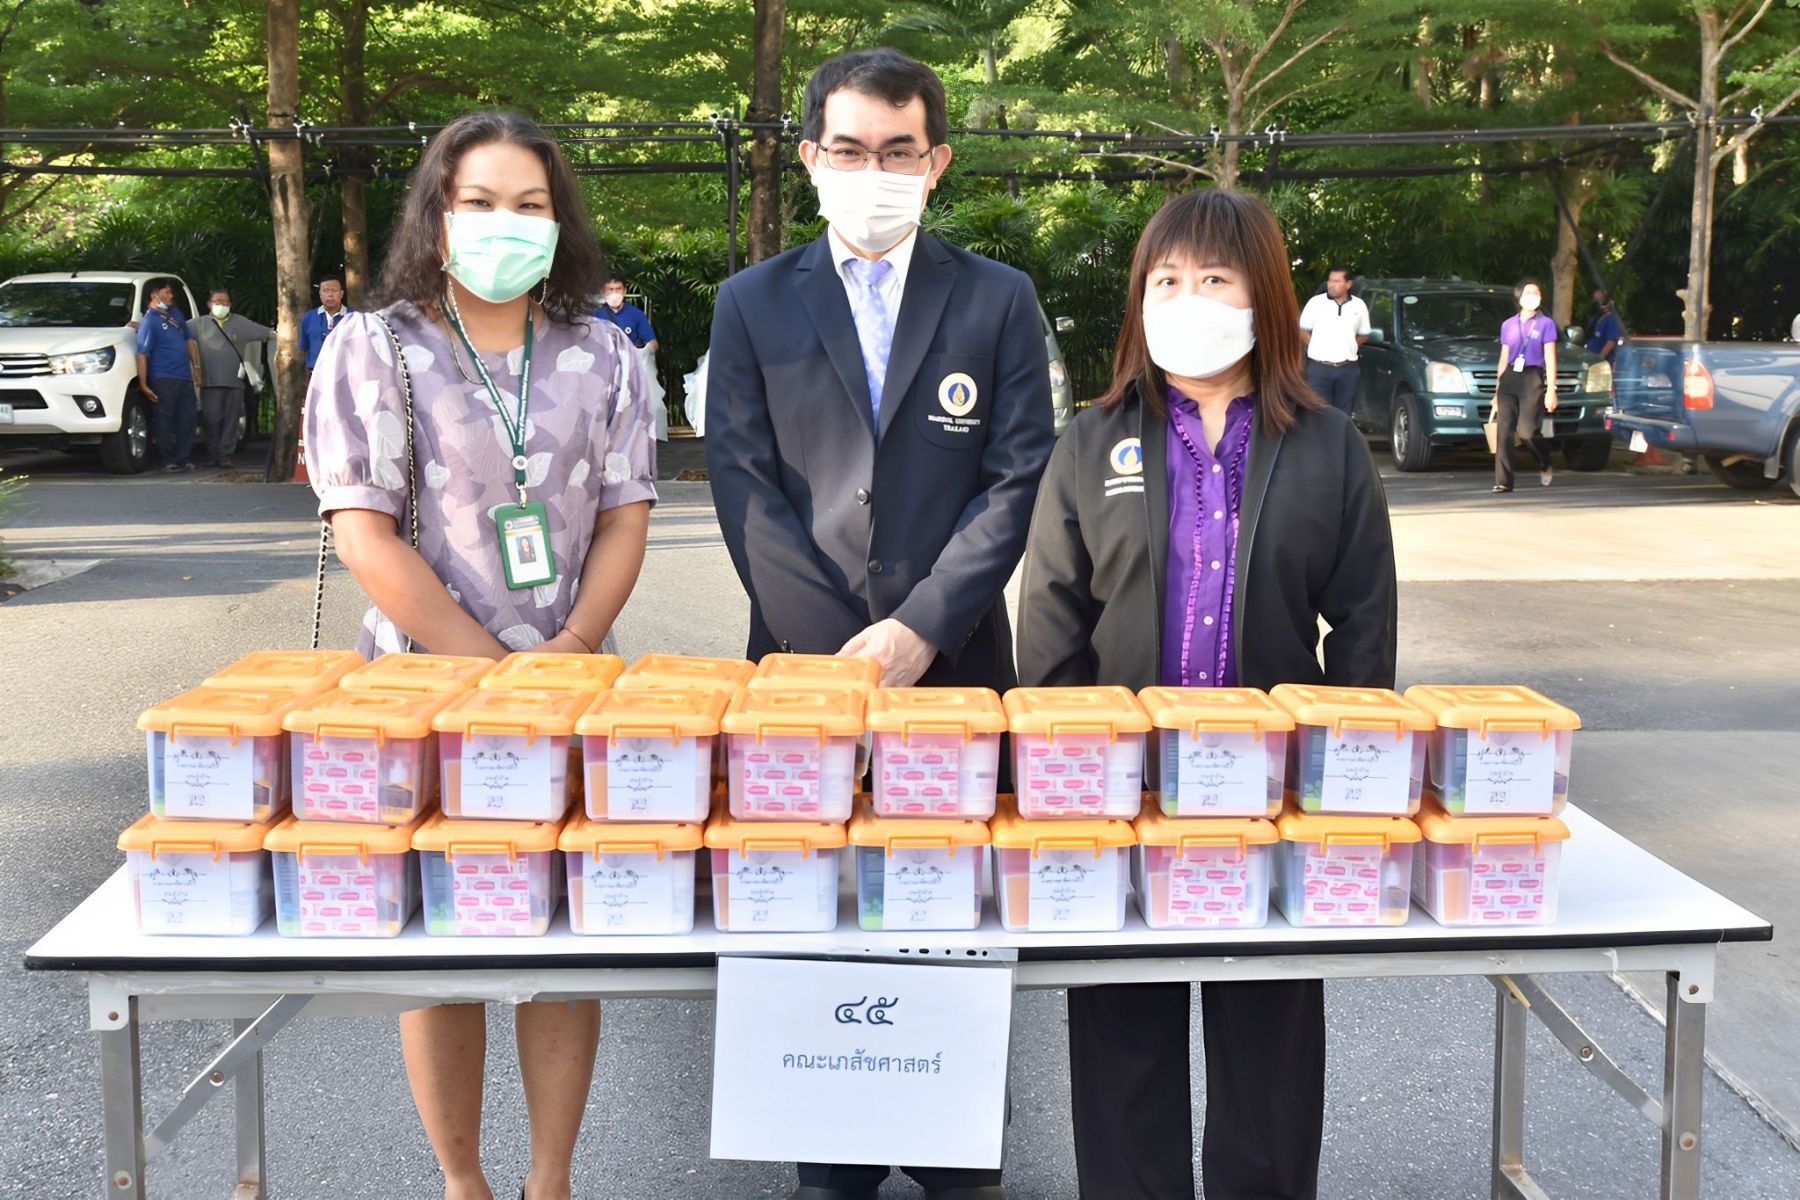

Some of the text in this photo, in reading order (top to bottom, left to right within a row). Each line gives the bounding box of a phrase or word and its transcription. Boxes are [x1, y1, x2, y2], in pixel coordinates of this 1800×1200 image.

[834, 995, 899, 1026] ๔๕
[782, 1048, 943, 1074] คณะเภสัชศาสตร์
